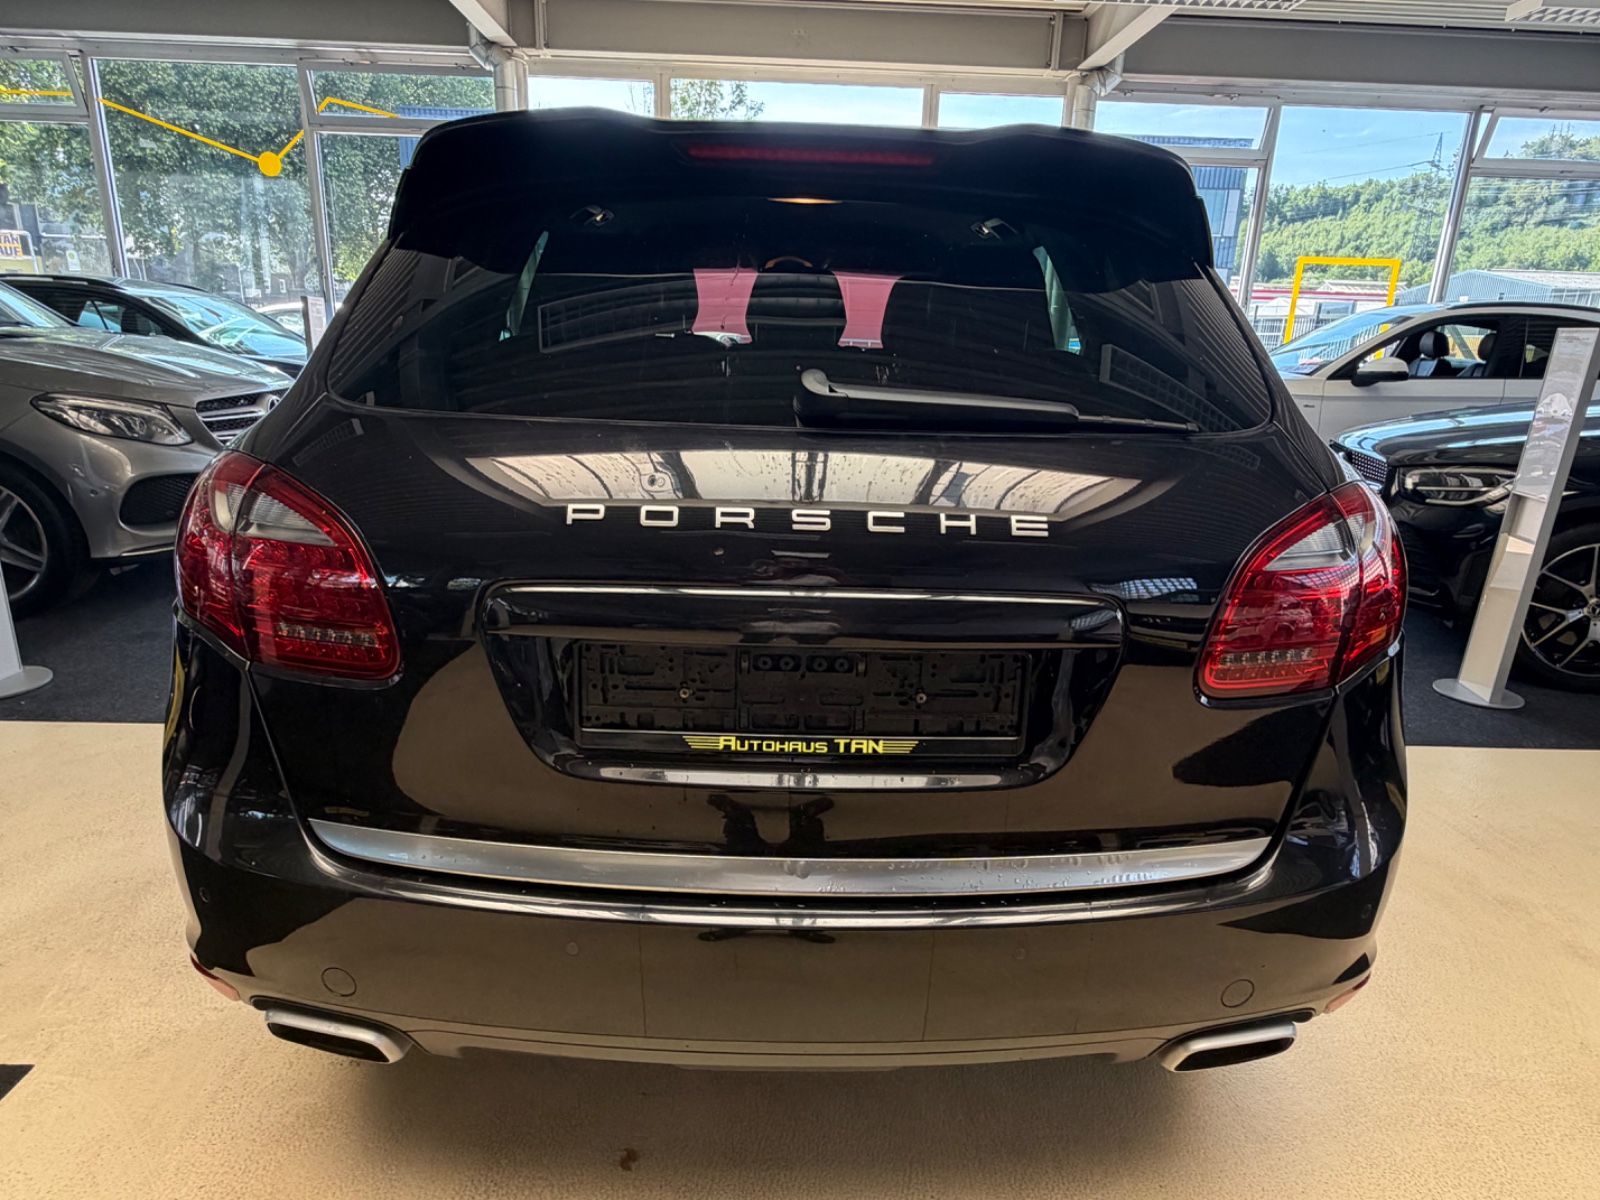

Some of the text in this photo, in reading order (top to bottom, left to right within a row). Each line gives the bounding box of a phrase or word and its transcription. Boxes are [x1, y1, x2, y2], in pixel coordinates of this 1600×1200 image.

[566, 503, 1049, 537] PORSCHE
[719, 736, 883, 753] AUTOHAUS TAN
